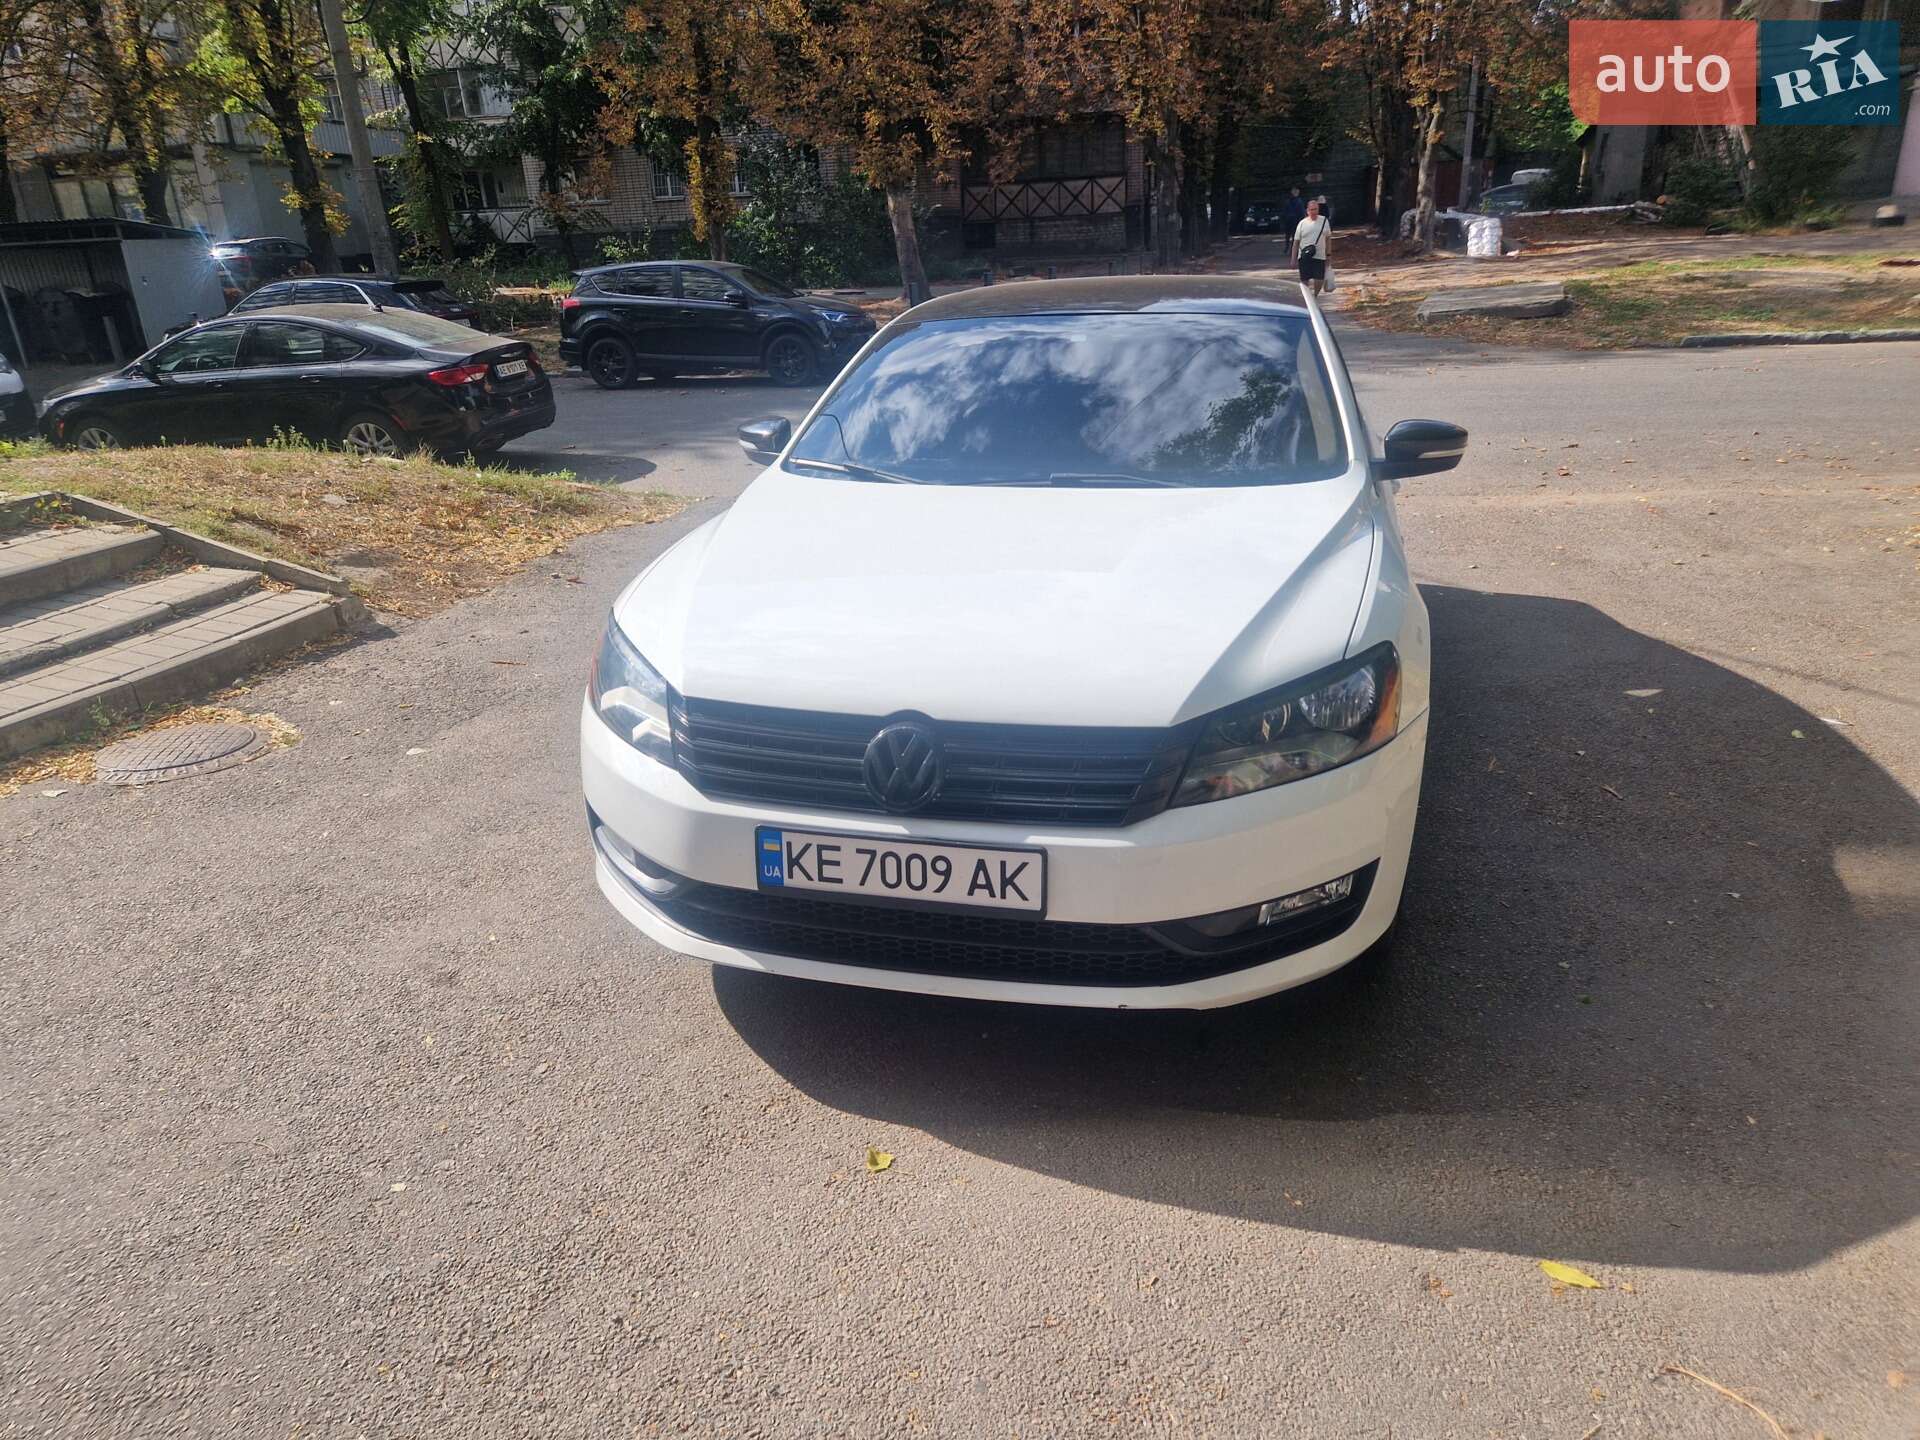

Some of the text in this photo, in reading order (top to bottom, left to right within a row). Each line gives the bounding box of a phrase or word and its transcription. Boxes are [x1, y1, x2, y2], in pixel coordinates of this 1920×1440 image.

[764, 864, 781, 878] UA
[786, 841, 1030, 902] KE 7009 AK
